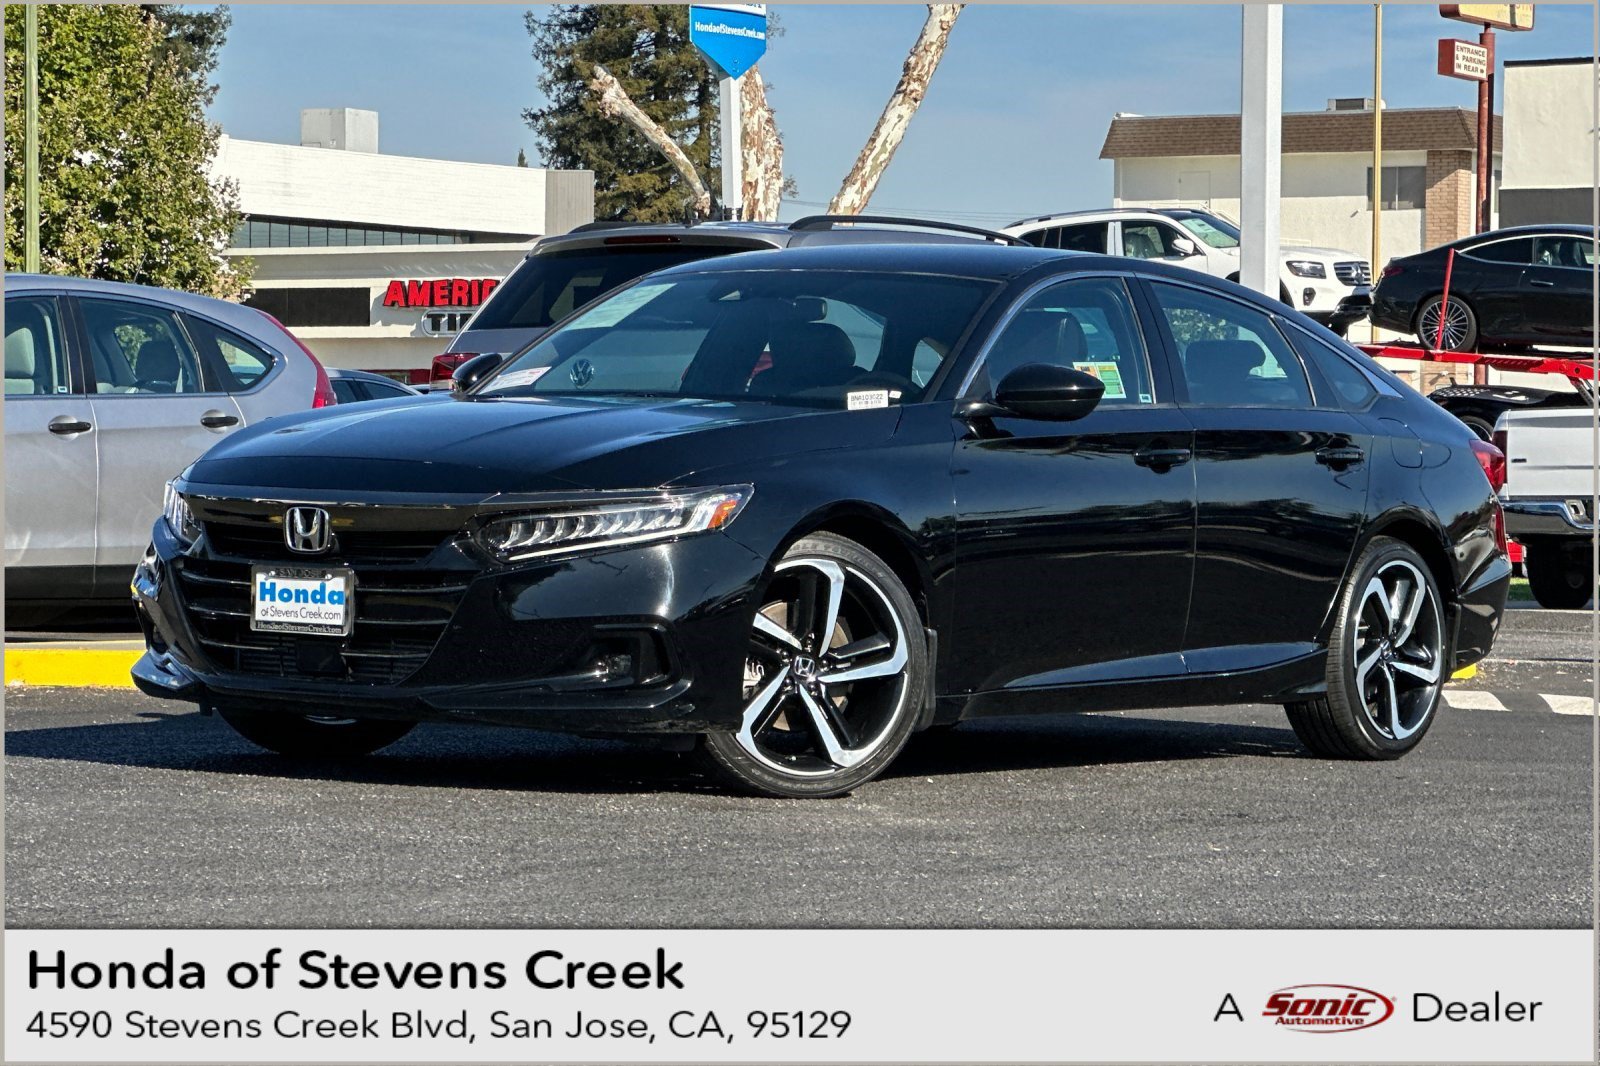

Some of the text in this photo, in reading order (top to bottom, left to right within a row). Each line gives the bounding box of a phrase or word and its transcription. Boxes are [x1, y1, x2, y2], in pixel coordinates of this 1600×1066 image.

[1456, 45, 1486, 58] ENTRANCE
[1462, 54, 1486, 66] PARKING
[1456, 62, 1479, 73] IN REAR
[427, 313, 473, 332] TI
[259, 582, 345, 605] Honda
[261, 605, 342, 620] of Stevens Creek.com
